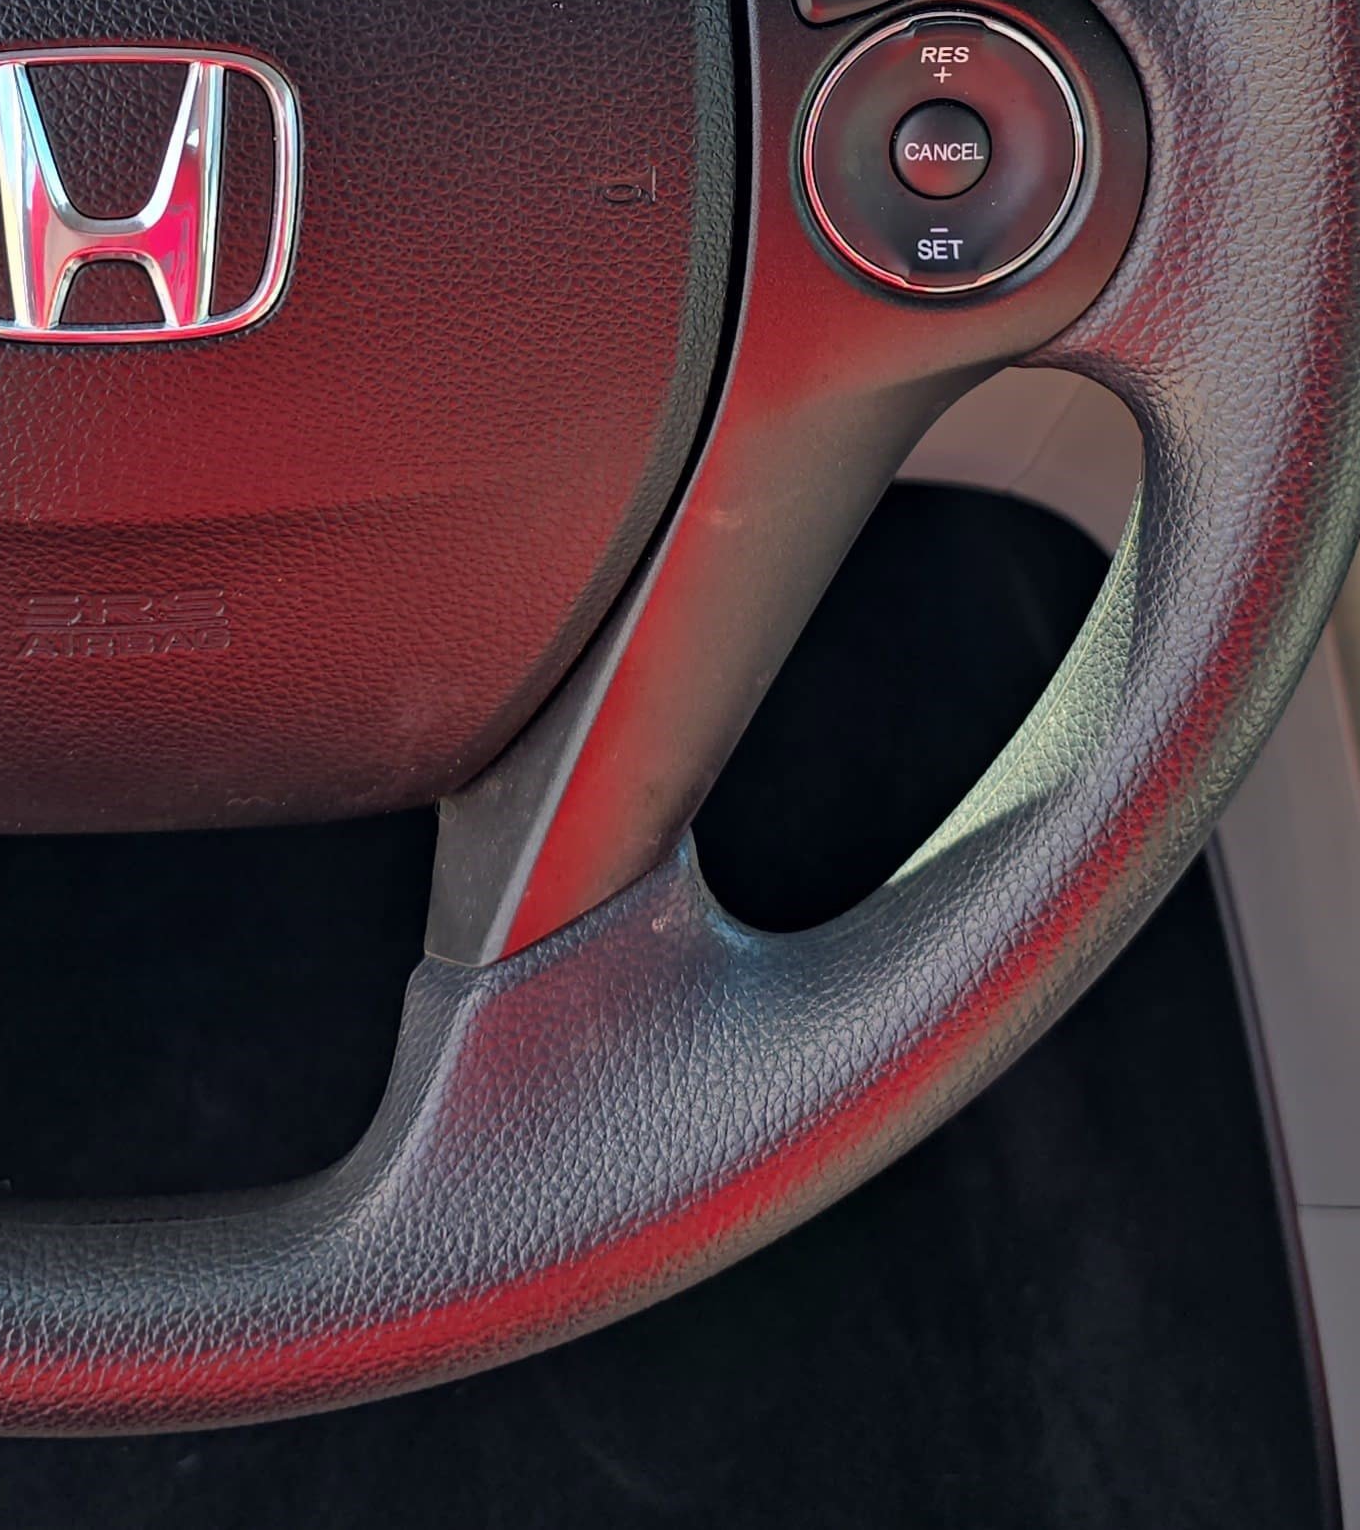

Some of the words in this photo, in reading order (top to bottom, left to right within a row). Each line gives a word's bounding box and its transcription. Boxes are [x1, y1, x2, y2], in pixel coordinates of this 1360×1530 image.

[920, 46, 970, 63] RES
[904, 142, 985, 162] CANCEL
[917, 239, 963, 260] SET
